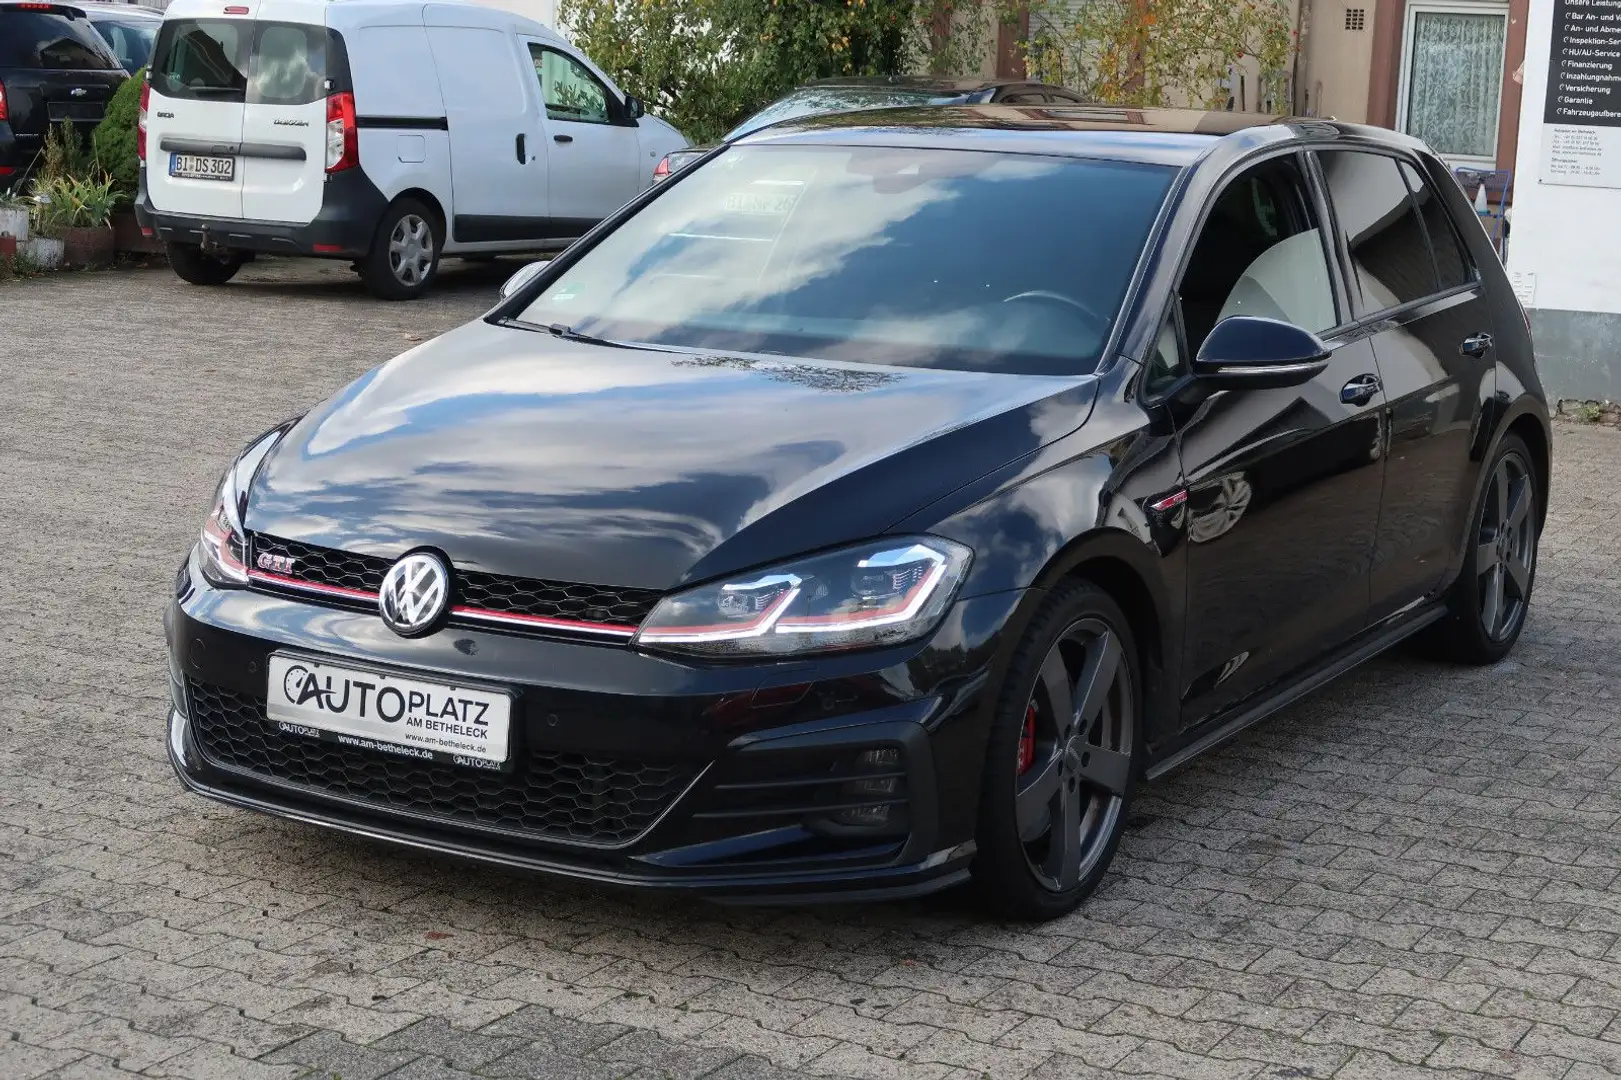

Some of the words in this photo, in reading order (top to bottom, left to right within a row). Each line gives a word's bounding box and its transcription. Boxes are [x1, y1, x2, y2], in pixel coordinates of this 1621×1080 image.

[1571, 12, 1584, 20] Bar
[1570, 24, 1584, 32] An-
[1568, 49, 1620, 57] HU/AU-Service
[1567, 60, 1613, 70] Finanzierung
[1565, 84, 1611, 94] Versicherung
[1564, 96, 1593, 104] Garantie
[176, 157, 188, 171] BI
[195, 158, 209, 173] DS
[210, 159, 231, 174] 302
[257, 552, 296, 575] GTI
[406, 716, 423, 729] AM
[425, 719, 489, 740] BETHELECK
[337, 733, 434, 760] www.am-betheleck.de
[405, 732, 487, 754] www.am-betheleck.de
